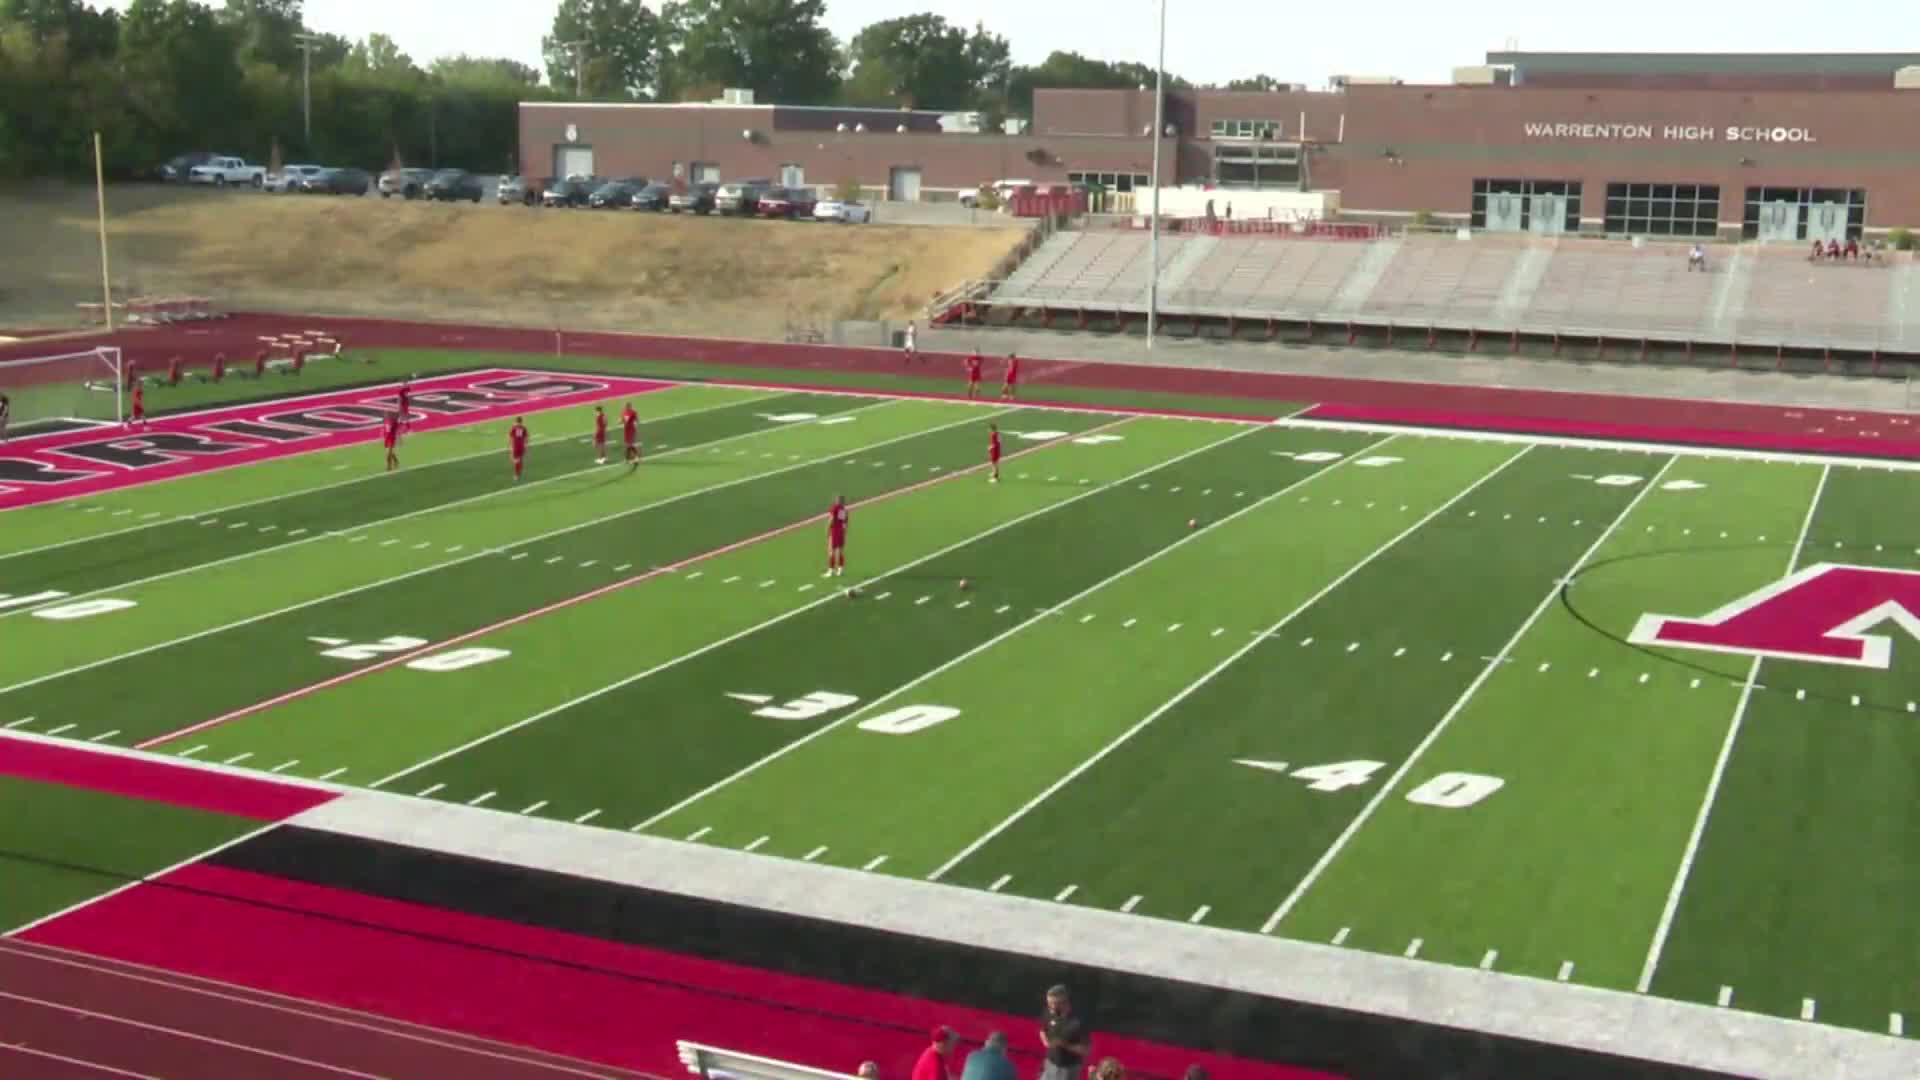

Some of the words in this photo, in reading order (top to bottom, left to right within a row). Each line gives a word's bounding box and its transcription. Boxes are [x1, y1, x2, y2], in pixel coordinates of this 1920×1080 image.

[1524, 123, 1653, 139] WARRENTON
[1663, 125, 1714, 141] HIGH
[1726, 126, 1817, 143] SCHOOL
[320, 635, 511, 671] 20
[752, 691, 961, 735] 30
[1290, 760, 1504, 808] 40
